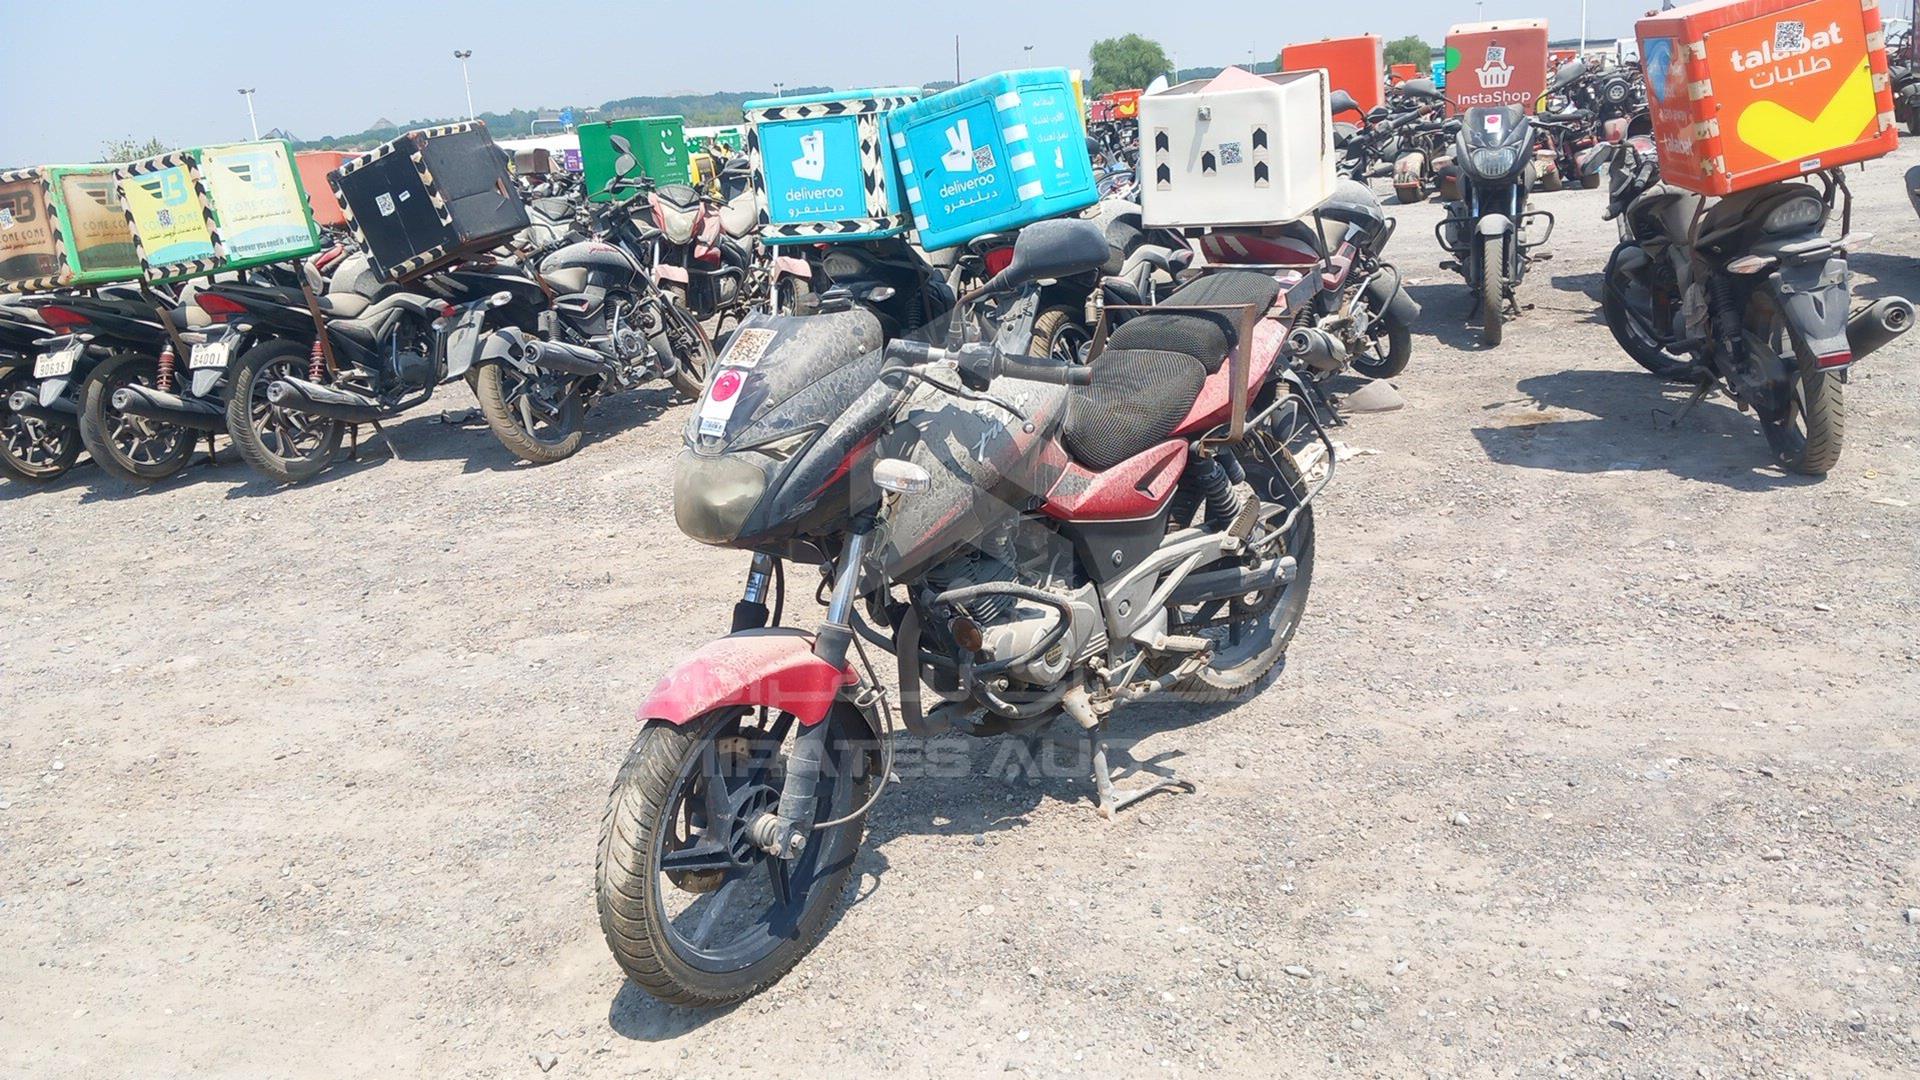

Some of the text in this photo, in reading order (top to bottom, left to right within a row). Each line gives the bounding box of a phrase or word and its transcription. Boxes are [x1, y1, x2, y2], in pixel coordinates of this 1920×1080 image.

[1749, 55, 1832, 89] طلبات
[1457, 90, 1531, 105] InstaShop
[940, 173, 996, 199] deliveroo
[785, 187, 844, 202] deliveroo
[0, 228, 45, 244] OME COME
